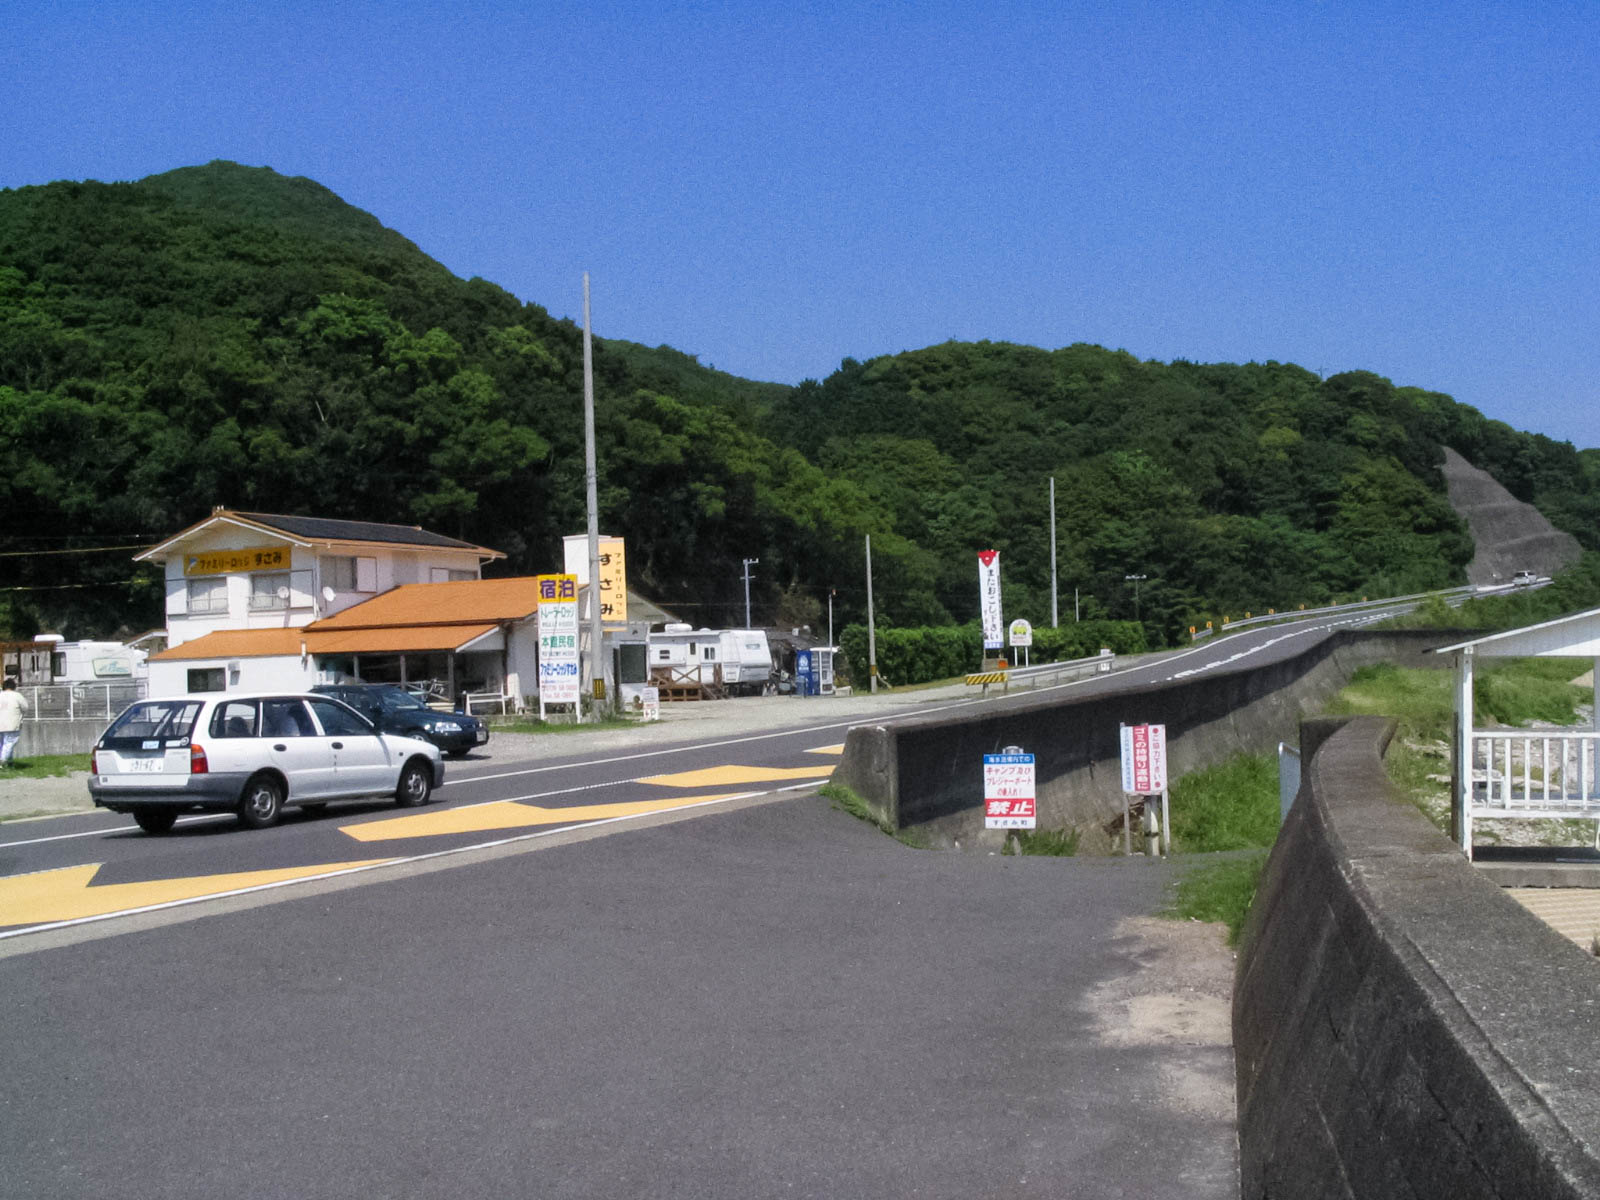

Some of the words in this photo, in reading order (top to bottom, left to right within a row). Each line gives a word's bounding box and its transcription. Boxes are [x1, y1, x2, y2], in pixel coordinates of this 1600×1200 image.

[255, 551, 283, 566] すさみ
[540, 578, 575, 599] 宿泊
[598, 552, 613, 616] すさみ
[986, 800, 1033, 815] 禁止
